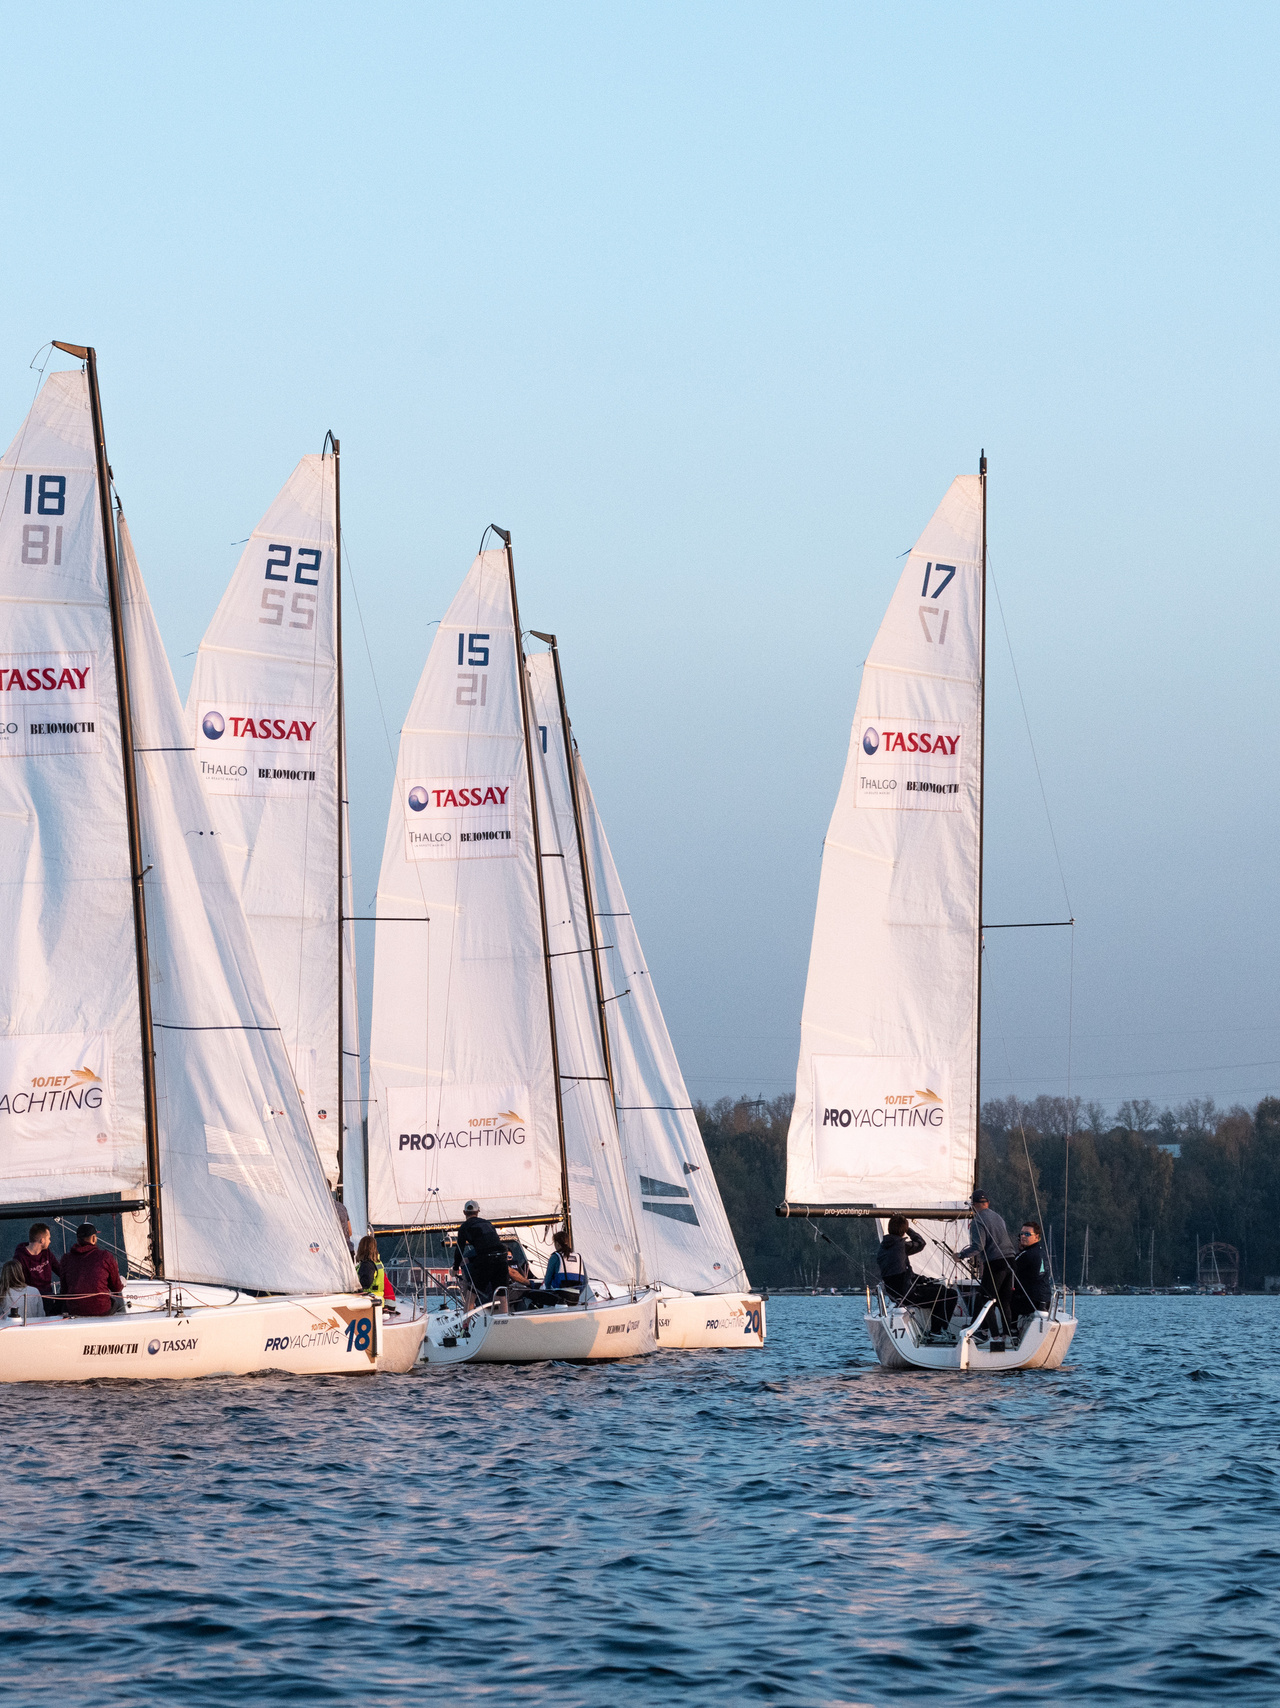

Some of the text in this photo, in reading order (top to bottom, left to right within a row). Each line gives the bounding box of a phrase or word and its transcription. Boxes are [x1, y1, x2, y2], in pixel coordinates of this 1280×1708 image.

[24, 474, 66, 515] 18
[265, 544, 322, 586] 22
[922, 562, 956, 599] 17
[458, 633, 489, 666] 15
[31, 723, 94, 734] ВЕДОМОСТИ
[229, 717, 316, 741] TASSAY
[882, 732, 960, 755] TASSAY
[259, 769, 315, 780] ВЕДОМОСТИ
[432, 787, 509, 807] TASSAY
[744, 1310, 760, 1334] 20
[892, 1328, 906, 1339] 17
[163, 1339, 198, 1351] TASSAY
[344, 1318, 372, 1352] 18
[83, 1344, 138, 1355] ВЕДОМОСТИ
